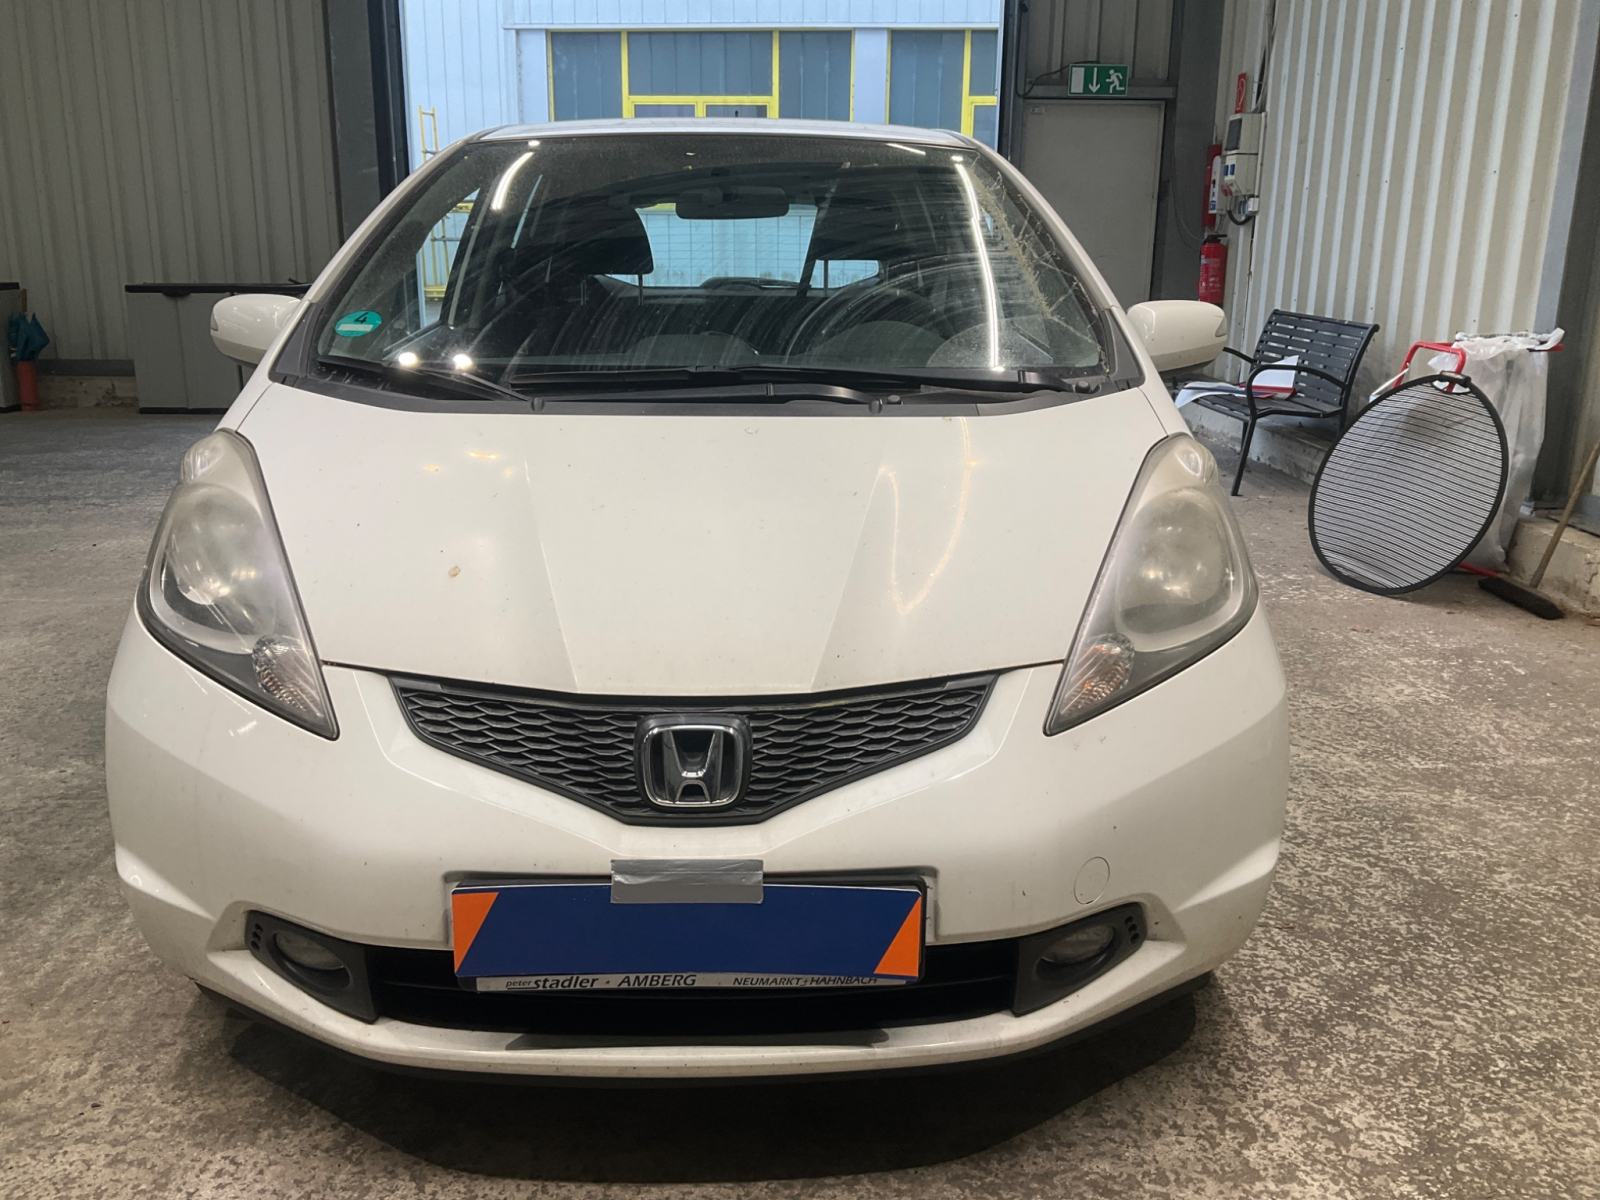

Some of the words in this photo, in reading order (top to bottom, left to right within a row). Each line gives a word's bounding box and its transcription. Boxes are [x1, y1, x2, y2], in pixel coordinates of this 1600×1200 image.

[353, 311, 369, 324] 4
[505, 979, 532, 988] peter
[533, 976, 599, 990] stadler
[617, 974, 697, 987] AMBERG
[733, 976, 801, 986] NEUMARKT
